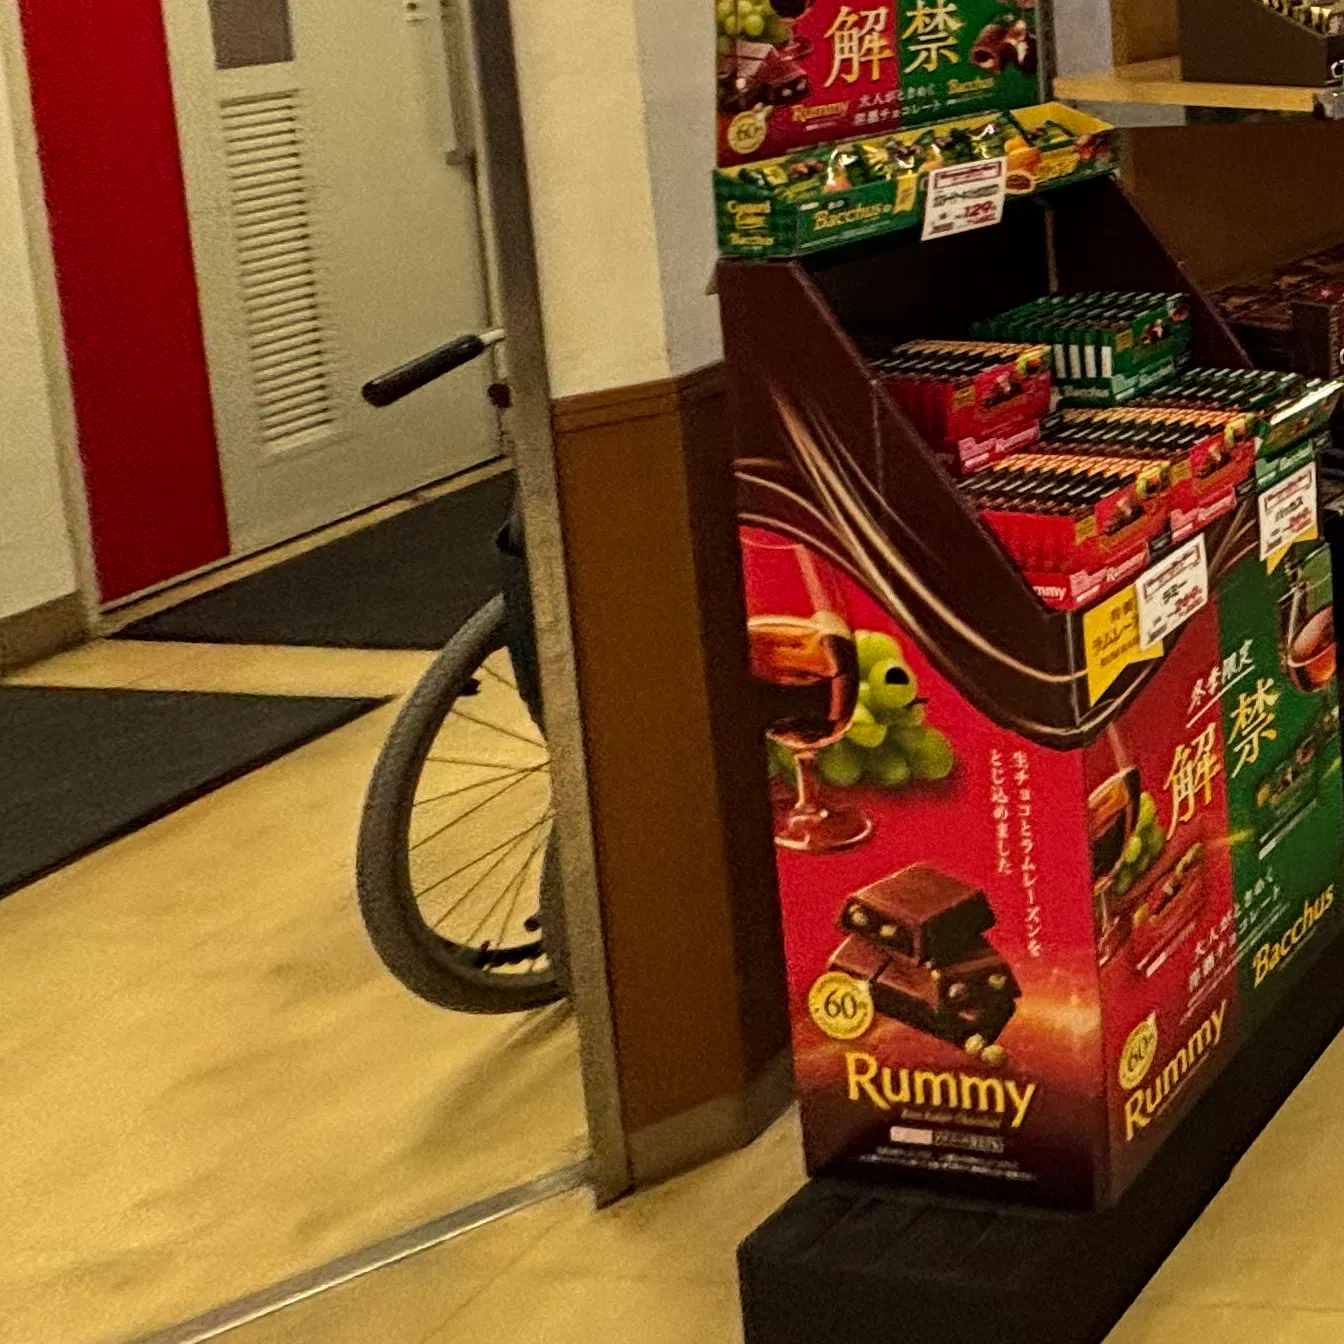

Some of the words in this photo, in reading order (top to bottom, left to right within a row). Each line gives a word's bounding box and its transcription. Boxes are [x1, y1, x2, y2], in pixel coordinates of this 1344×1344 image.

[1012, 750, 1042, 957] 生チョコとラムレーズンを
[1252, 883, 1335, 989] Bacchus
[824, 990, 858, 1019] 60
[844, 1052, 1037, 1128] Rummy
[1124, 998, 1227, 1142] Rummy
